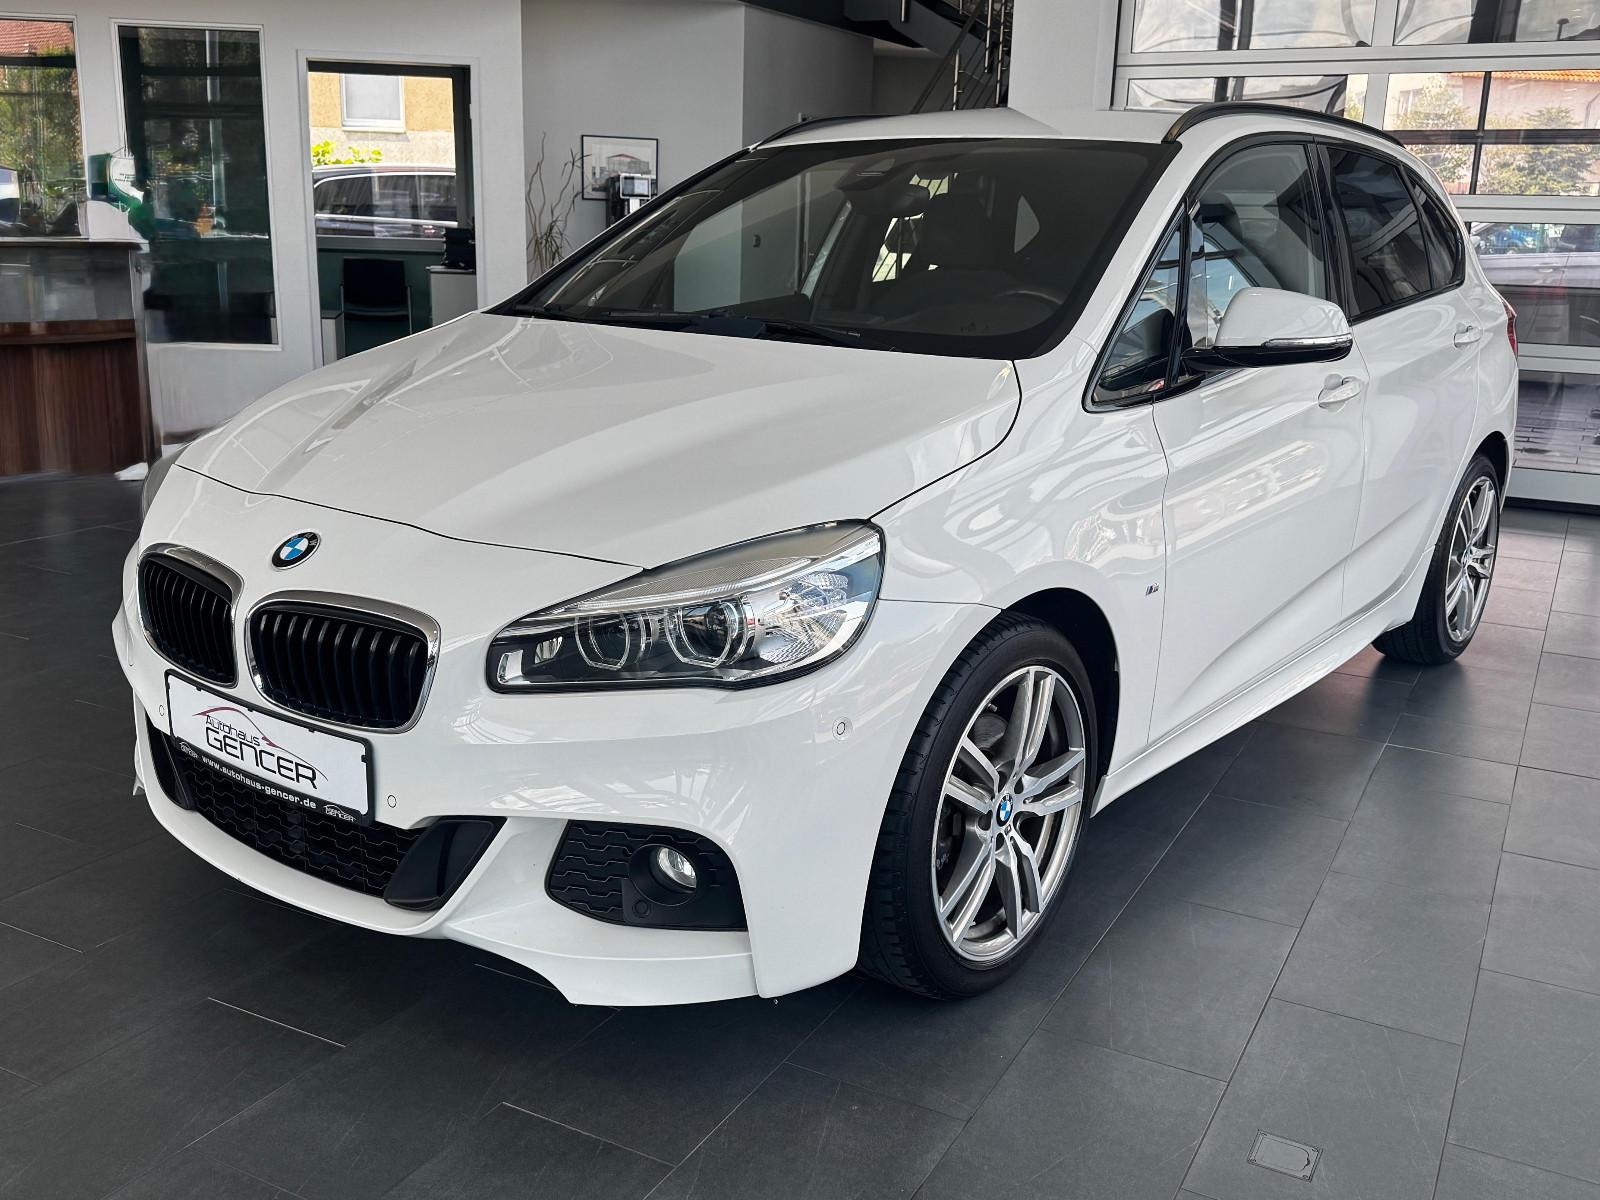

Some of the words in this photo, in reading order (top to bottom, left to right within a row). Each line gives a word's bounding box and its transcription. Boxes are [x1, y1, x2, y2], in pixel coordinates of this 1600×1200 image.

[206, 715, 260, 747] Autohaus
[206, 727, 317, 789] GENCER
[201, 755, 317, 809] www.autohaus-gencer.de
